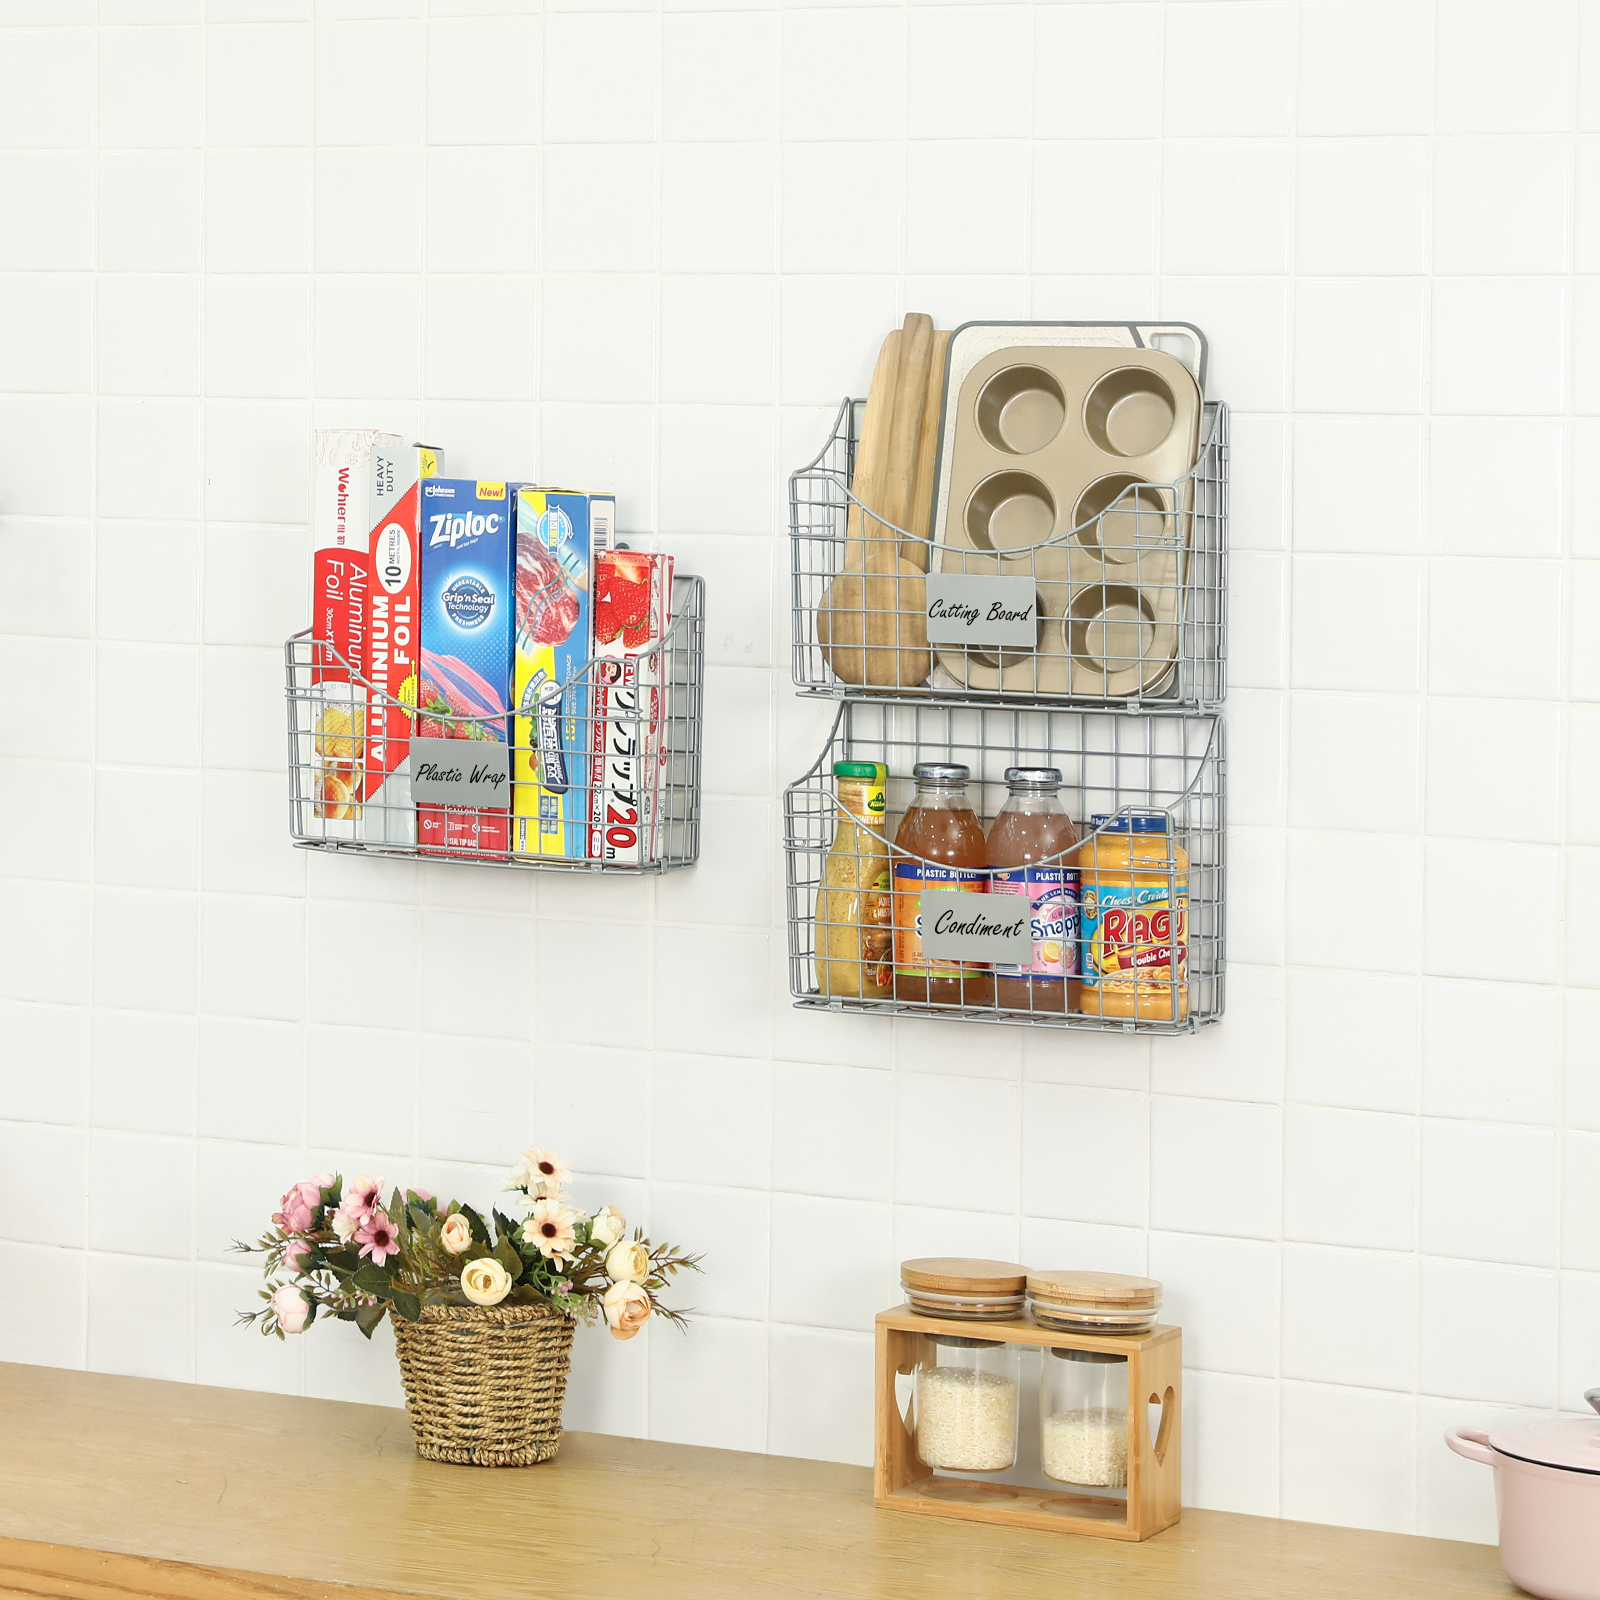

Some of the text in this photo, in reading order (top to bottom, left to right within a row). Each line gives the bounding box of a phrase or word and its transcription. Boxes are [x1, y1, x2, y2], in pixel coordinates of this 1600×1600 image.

[376, 455, 384, 496] HEAVY
[386, 460, 394, 492] DUTY
[479, 487, 503, 497] New!
[429, 510, 499, 548] Ziploc
[388, 529, 396, 564] METRES
[325, 559, 344, 601] Foil
[384, 566, 402, 587] 10
[447, 602, 489, 613] Technology
[471, 594, 495, 605] Seal
[929, 598, 1033, 626] Cutting Board
[394, 595, 411, 664] FOIL
[451, 612, 485, 626] FRESHNESS
[415, 762, 507, 790] Plastic Wrap
[459, 838, 467, 846] TOP
[1050, 889, 1077, 898] LEMNADE
[934, 909, 1025, 939] Condiment
[1031, 914, 1081, 941] Snapp
[1131, 952, 1157, 967] Double
